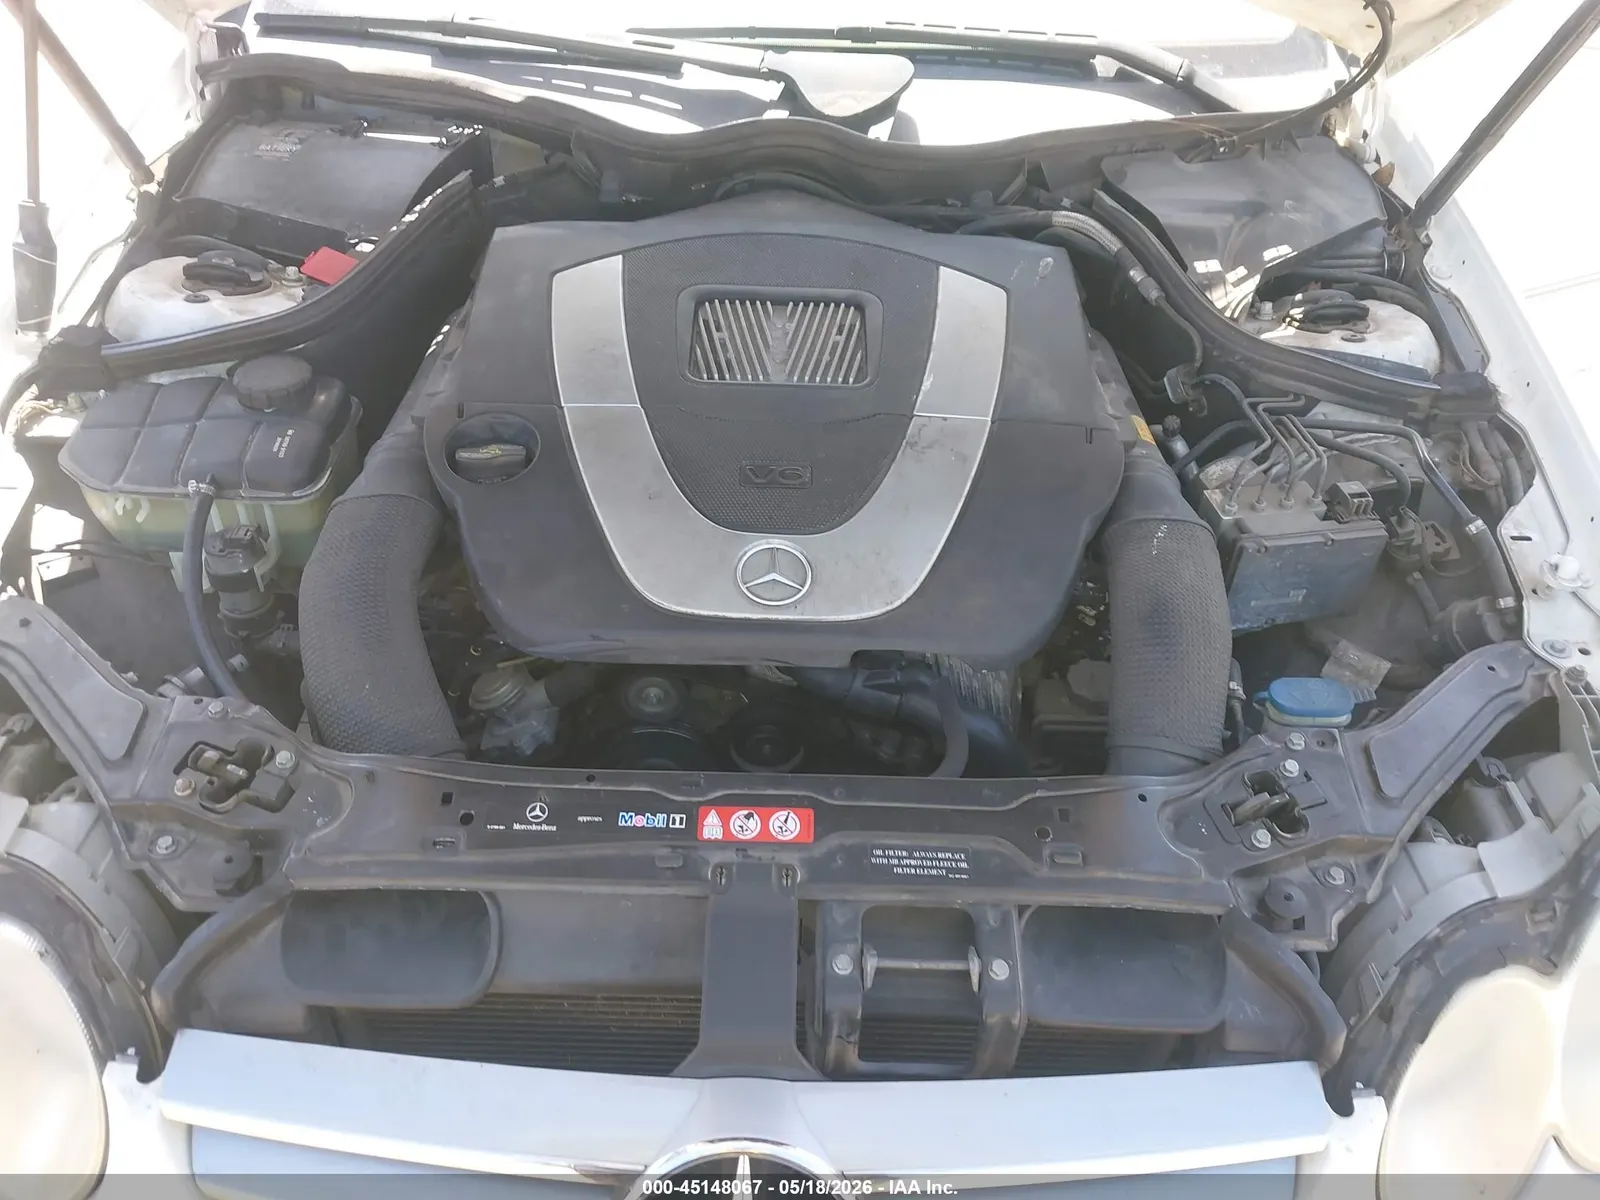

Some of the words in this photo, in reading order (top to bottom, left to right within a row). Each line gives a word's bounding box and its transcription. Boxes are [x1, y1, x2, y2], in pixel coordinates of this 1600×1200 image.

[618, 812, 667, 828] Mobil
[913, 850, 937, 859] ALWAYS
[937, 851, 966, 860] REPLACE
[870, 856, 888, 865] WITH
[900, 858, 932, 867] APPROVED
[893, 866, 916, 875] FILTER
[916, 868, 946, 876] ELEMENT
